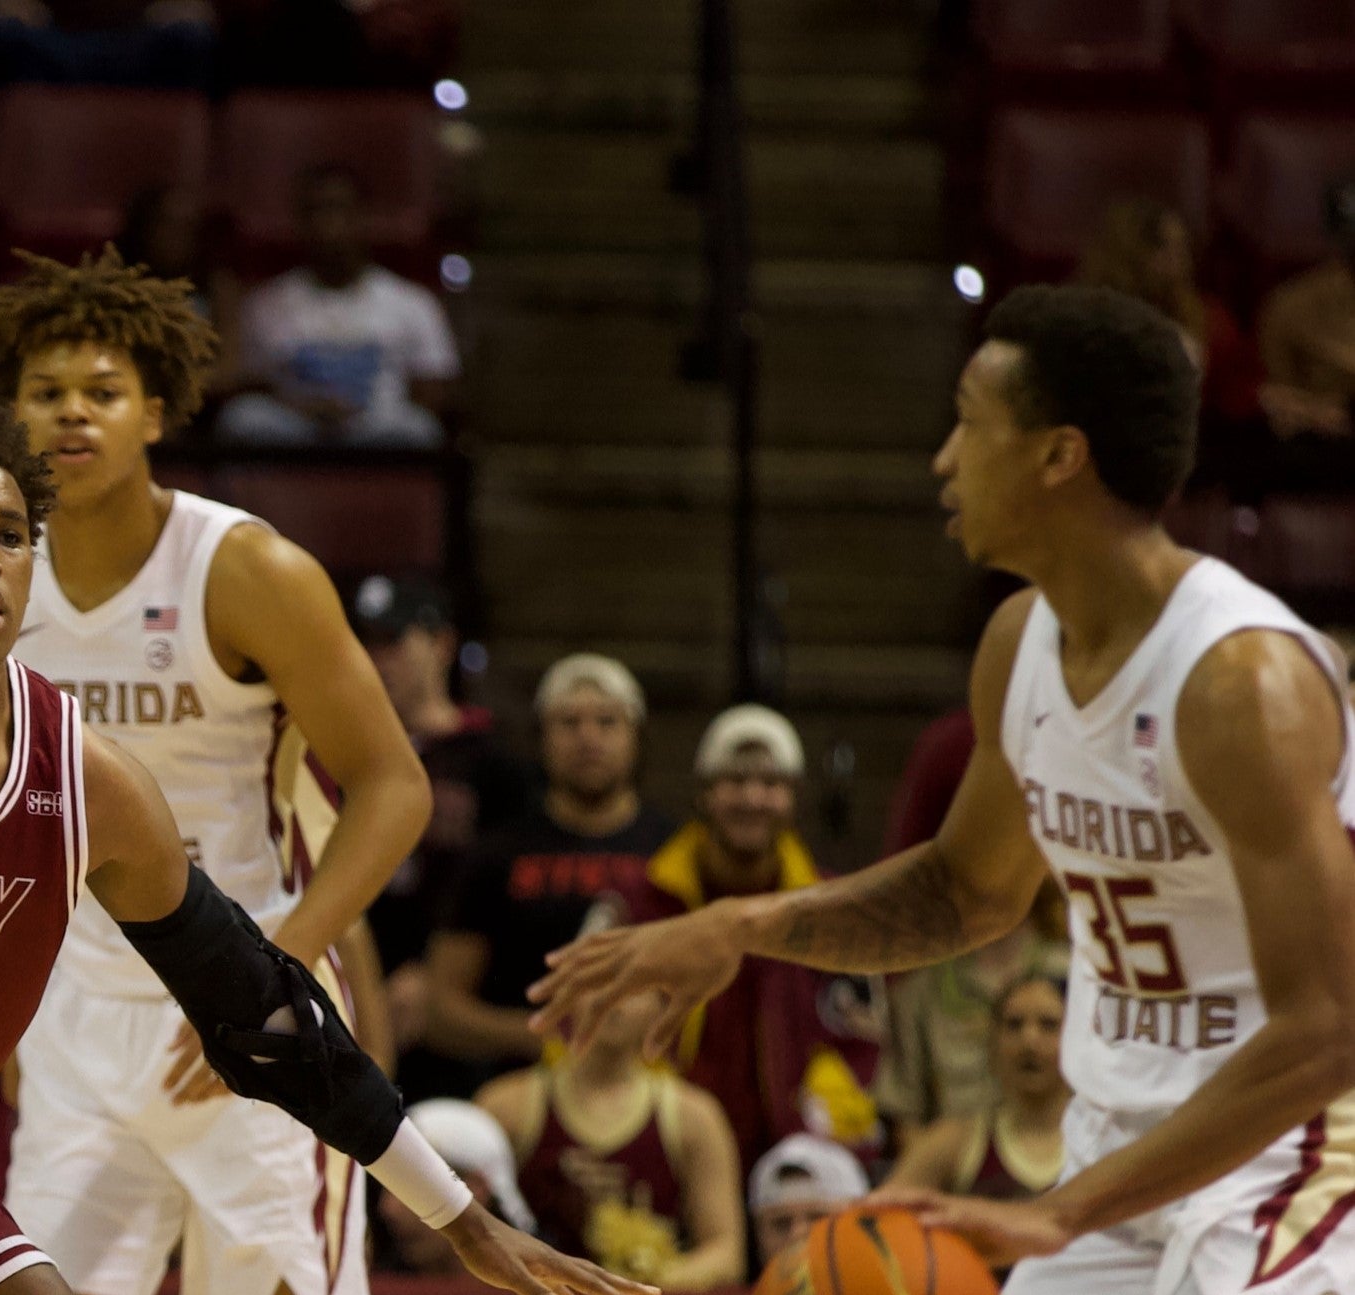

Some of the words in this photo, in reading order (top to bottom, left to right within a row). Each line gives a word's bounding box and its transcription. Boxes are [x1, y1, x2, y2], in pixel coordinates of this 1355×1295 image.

[53, 679, 205, 724] RIDA
[1023, 777, 1214, 863] FLORIDA
[1063, 871, 1189, 993] 35
